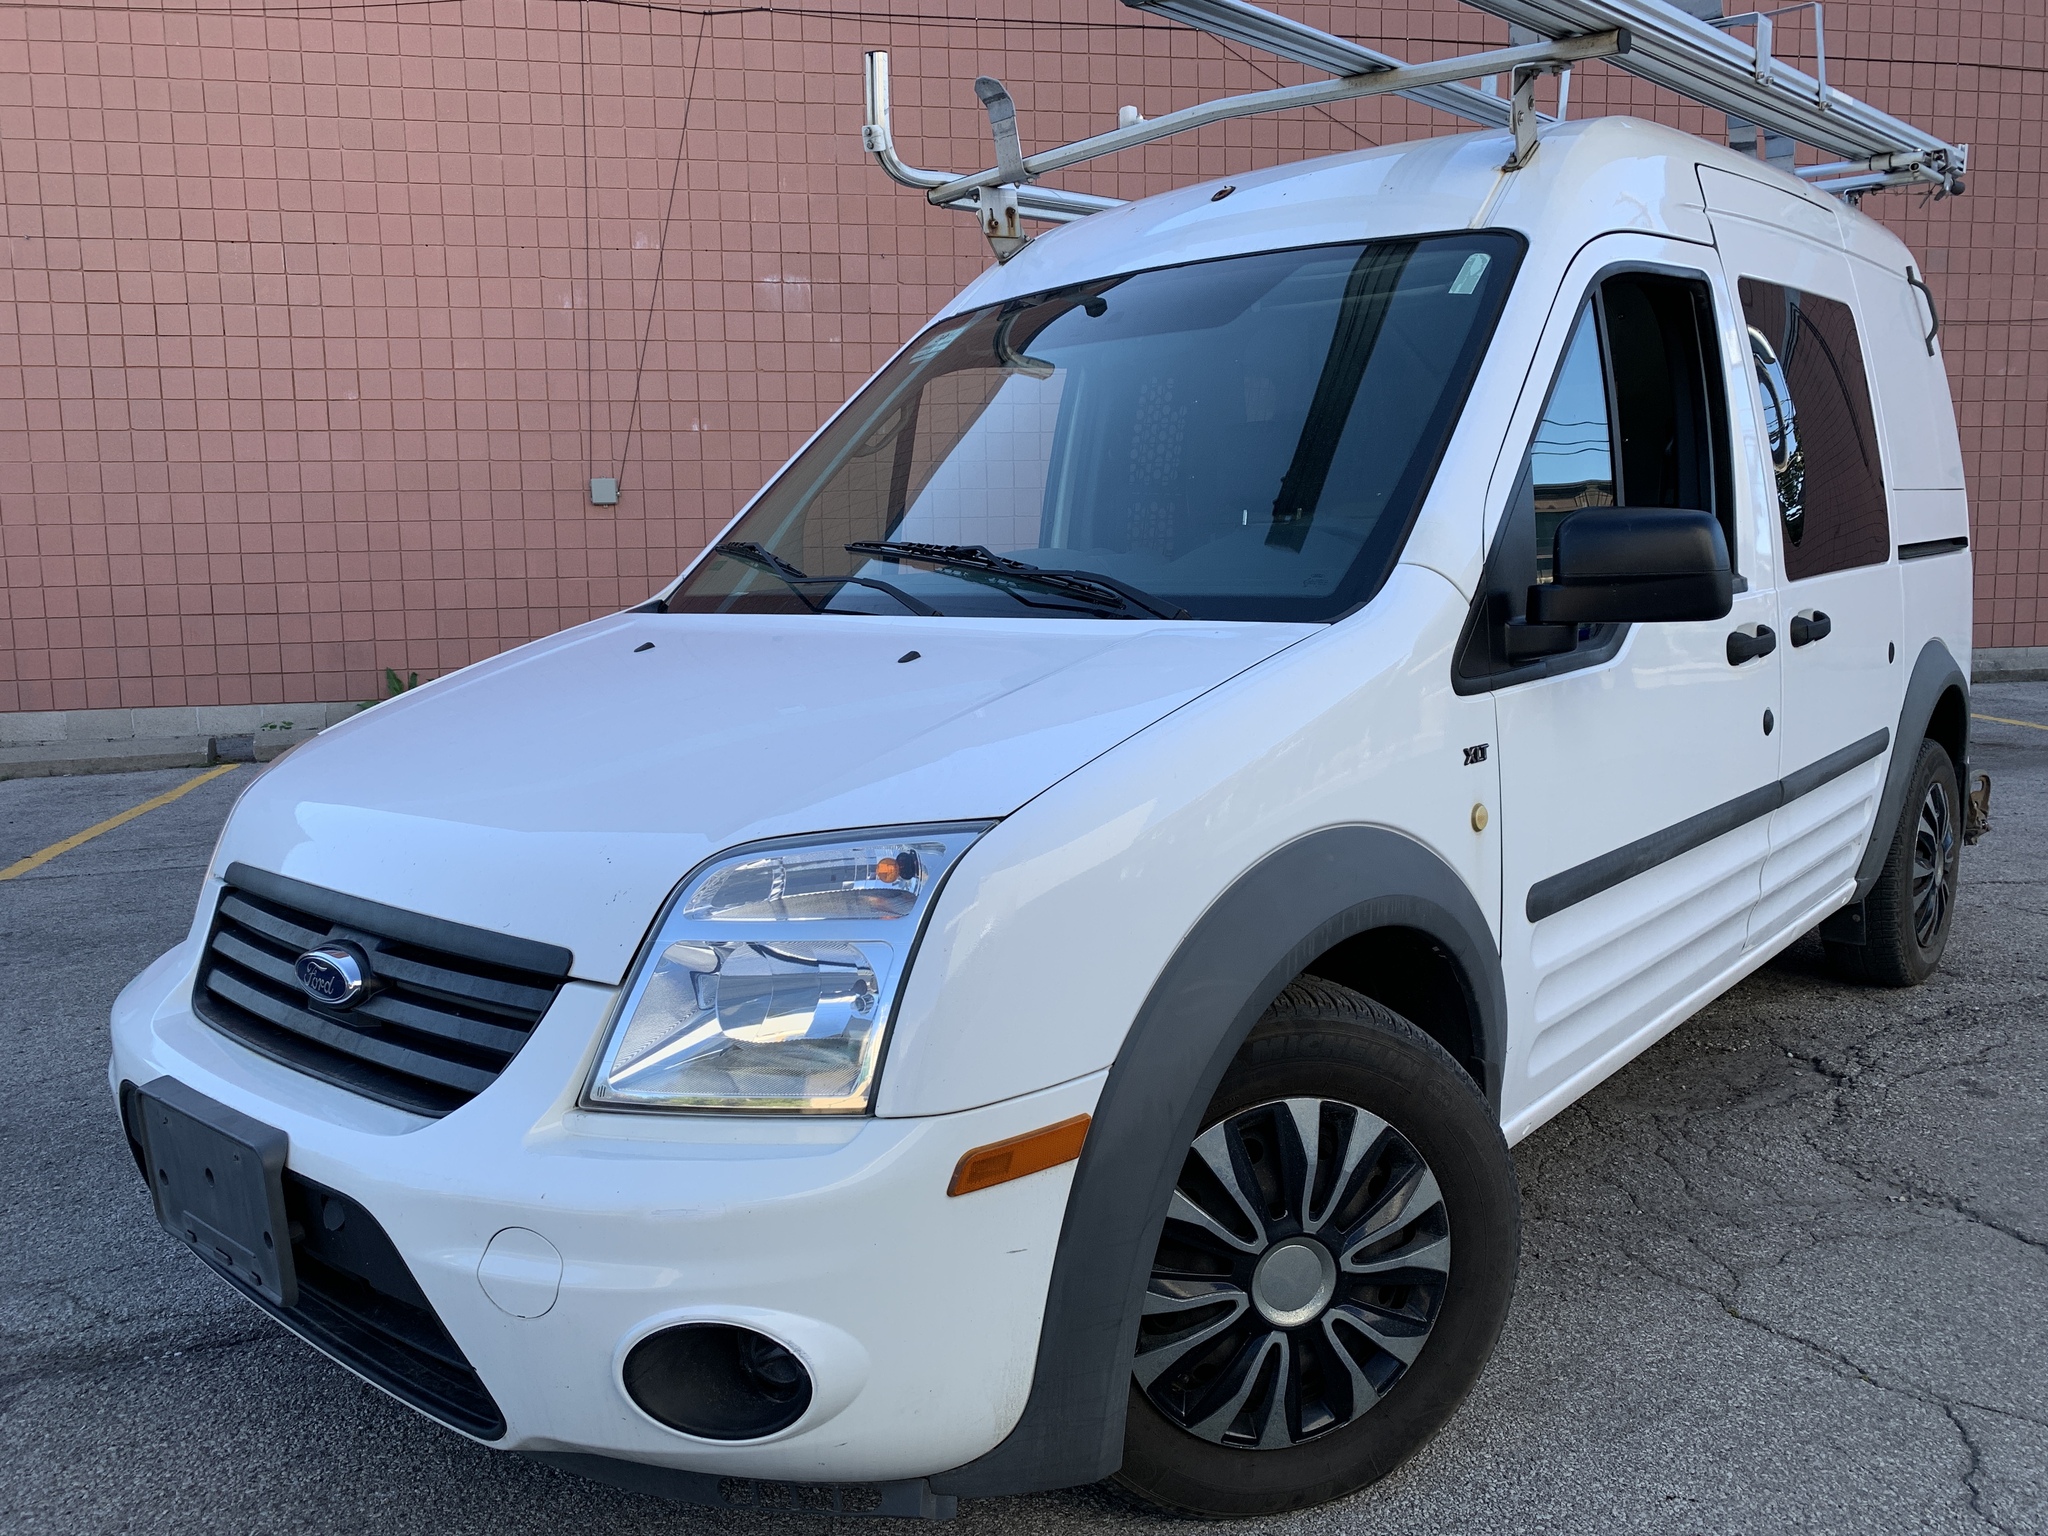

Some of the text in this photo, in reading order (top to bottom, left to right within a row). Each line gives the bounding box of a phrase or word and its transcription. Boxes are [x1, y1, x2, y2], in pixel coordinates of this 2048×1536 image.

[1463, 743, 1489, 766] XLT
[304, 961, 335, 995] Ford
[1251, 1034, 1423, 1079] MICHELIN
